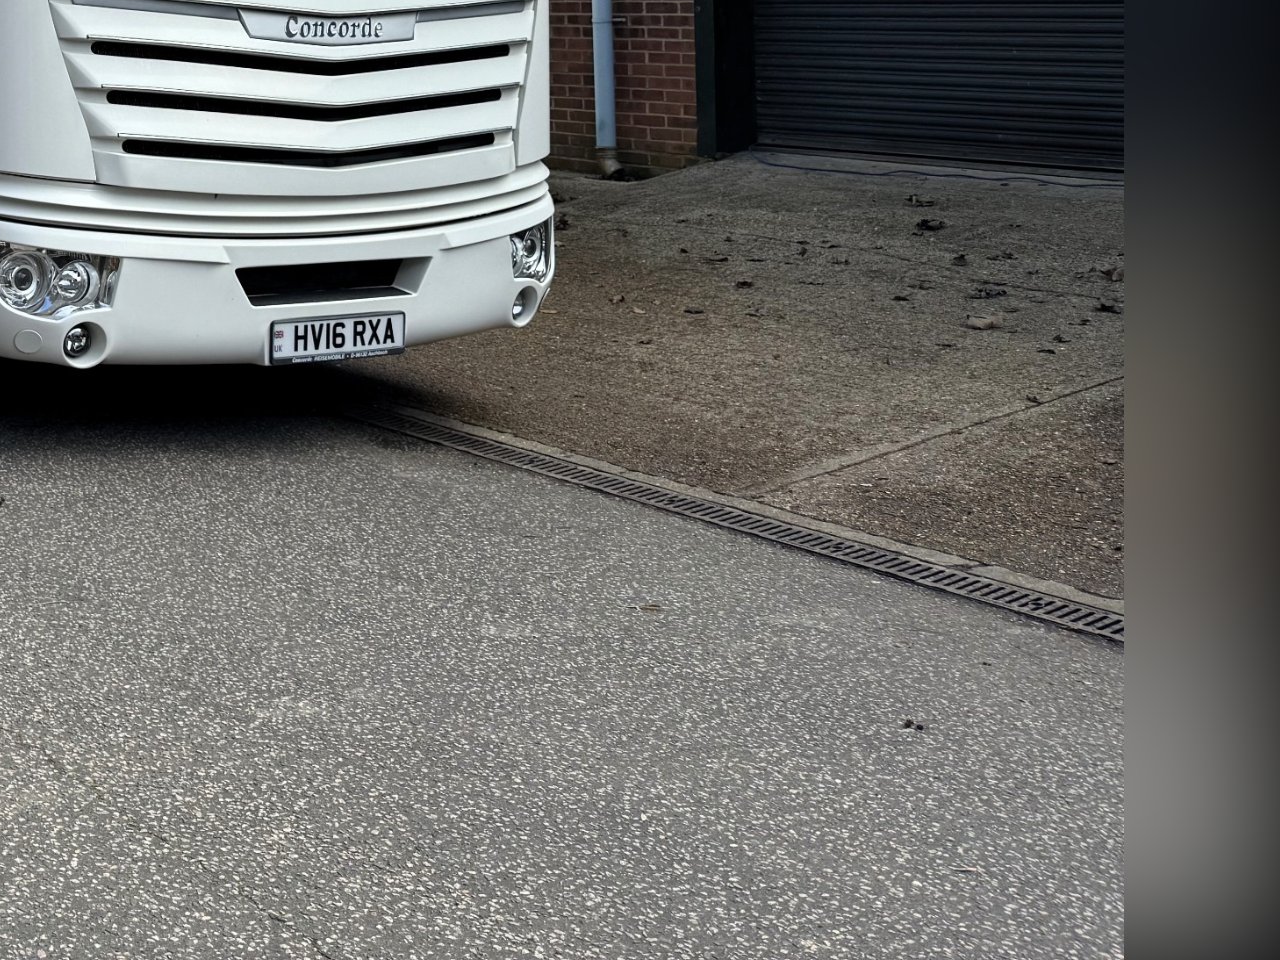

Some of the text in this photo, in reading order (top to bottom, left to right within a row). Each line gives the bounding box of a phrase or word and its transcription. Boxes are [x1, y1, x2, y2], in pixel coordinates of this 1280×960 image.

[284, 15, 383, 39] Concorde
[293, 317, 395, 352] HV16 RXA
[274, 344, 283, 353] UK
